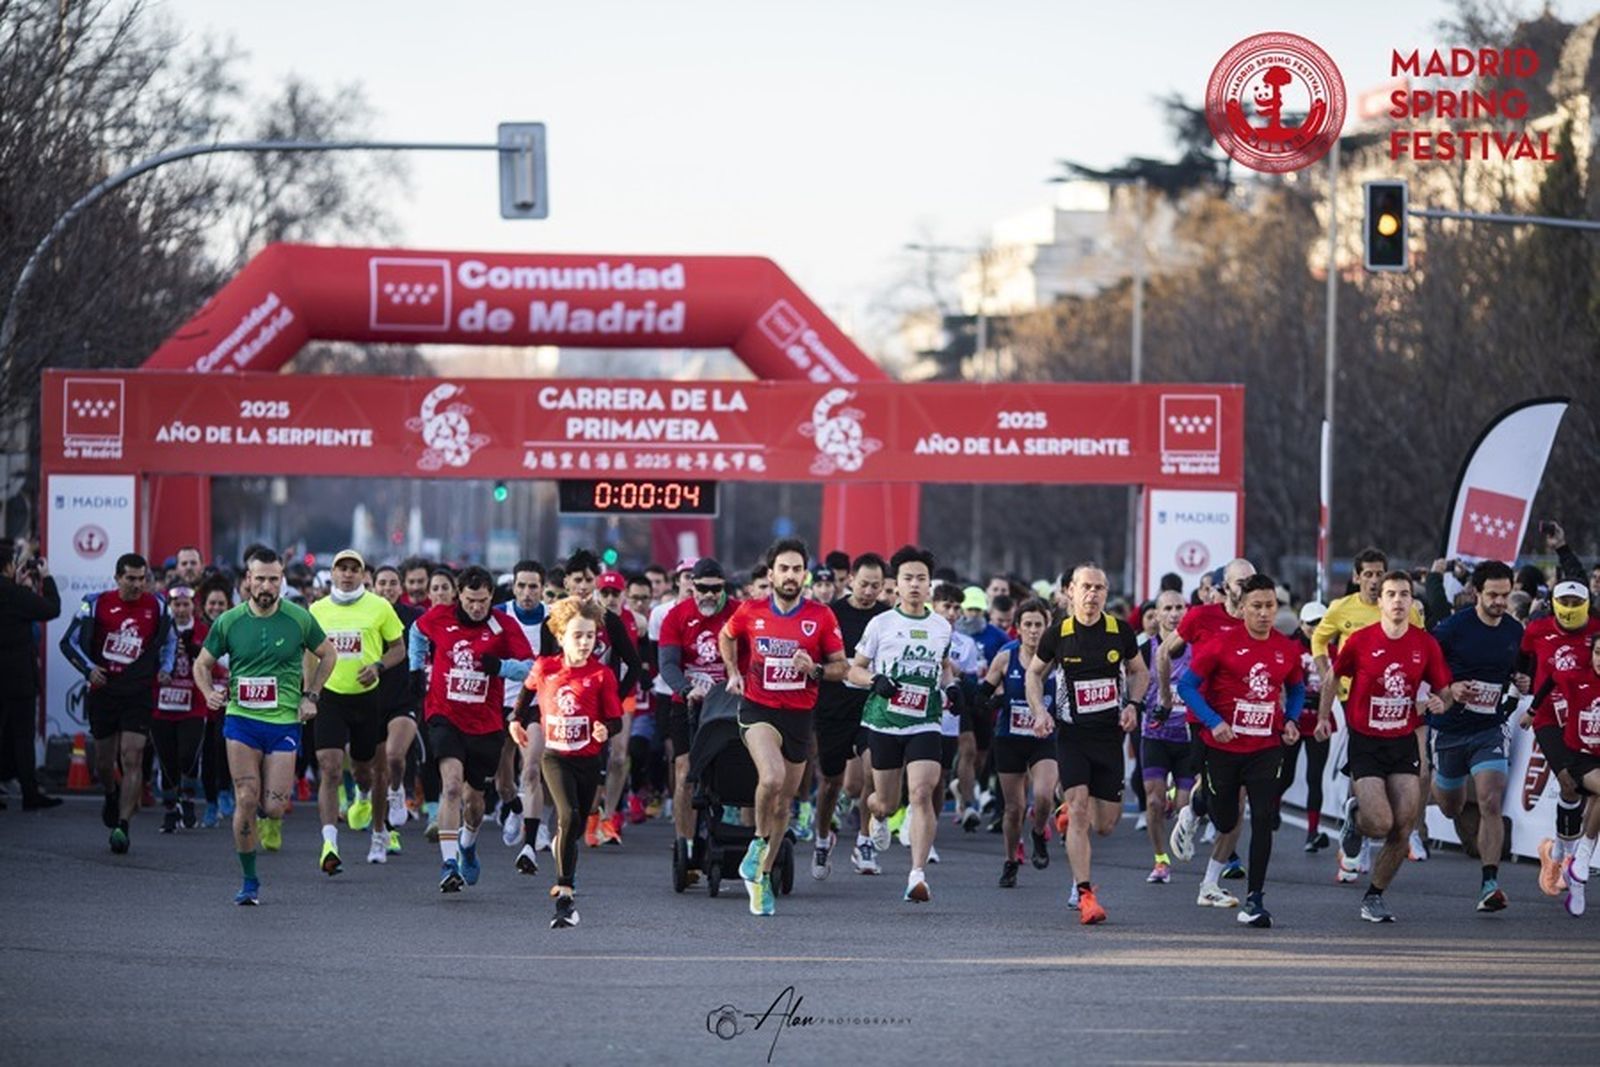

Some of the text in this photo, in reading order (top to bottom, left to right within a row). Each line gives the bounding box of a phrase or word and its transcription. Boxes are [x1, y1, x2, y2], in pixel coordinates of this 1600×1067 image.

[457, 260, 686, 290] Comunidad
[458, 300, 686, 334] de Madrid
[538, 387, 748, 412] CARRERA DE LA
[239, 401, 290, 419] 2025
[997, 412, 1048, 429] 2025
[155, 422, 374, 447] AÑO DE LA SERPIENTE
[566, 416, 719, 442] PRIMAVERA
[64, 437, 122, 449] Comunidad
[914, 433, 1130, 457] AÑO DE LA SERPIENTE
[64, 449, 122, 459] de Madrid
[634, 453, 671, 469] 2025
[1178, 464, 1220, 475] Madrid
[73, 495, 129, 509] MADRID
[594, 482, 701, 509] 0:00:04
[1175, 511, 1230, 525] MADRID
[772, 666, 798, 680] 2763
[245, 685, 269, 699] 1973
[457, 677, 481, 691] 2412
[1084, 687, 1110, 702] 3040
